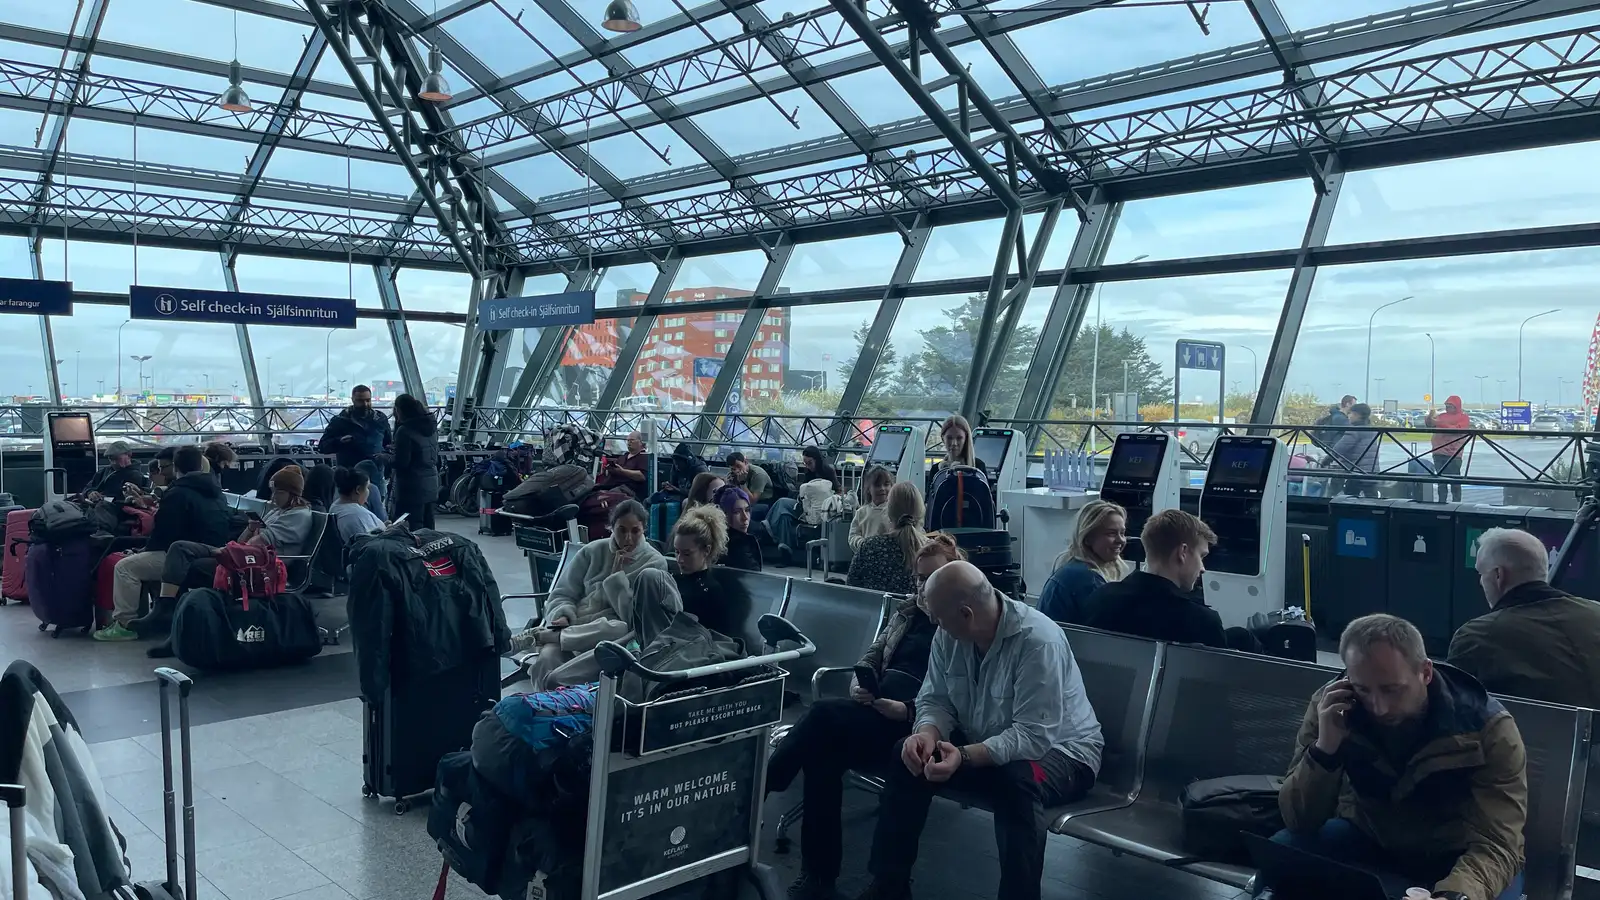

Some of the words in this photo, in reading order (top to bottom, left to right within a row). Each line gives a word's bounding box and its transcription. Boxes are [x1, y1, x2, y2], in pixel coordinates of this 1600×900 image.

[8, 299, 41, 309] farangur
[180, 299, 206, 312] Self
[208, 301, 262, 315] check-in
[266, 304, 338, 319] Sjálfsinnritun
[498, 307, 511, 319] Self
[510, 306, 537, 318] check-in
[539, 304, 580, 319] Sjálfsinnritun
[1231, 460, 1249, 469] KEF
[246, 630, 265, 639] REI
[669, 722, 683, 731] BUT
[684, 716, 709, 727] PLEASE
[711, 710, 735, 721] ESCORT
[746, 704, 762, 713] BACK
[688, 709, 704, 718] TAKE
[706, 706, 716, 714] ME
[717, 703, 733, 712] WITH
[634, 787, 669, 806] WARM
[674, 770, 728, 794] WELCOME
[621, 807, 645, 823] IT'S
[649, 802, 662, 815] IN
[666, 795, 690, 809] OUR
[694, 781, 737, 802] NATURE
